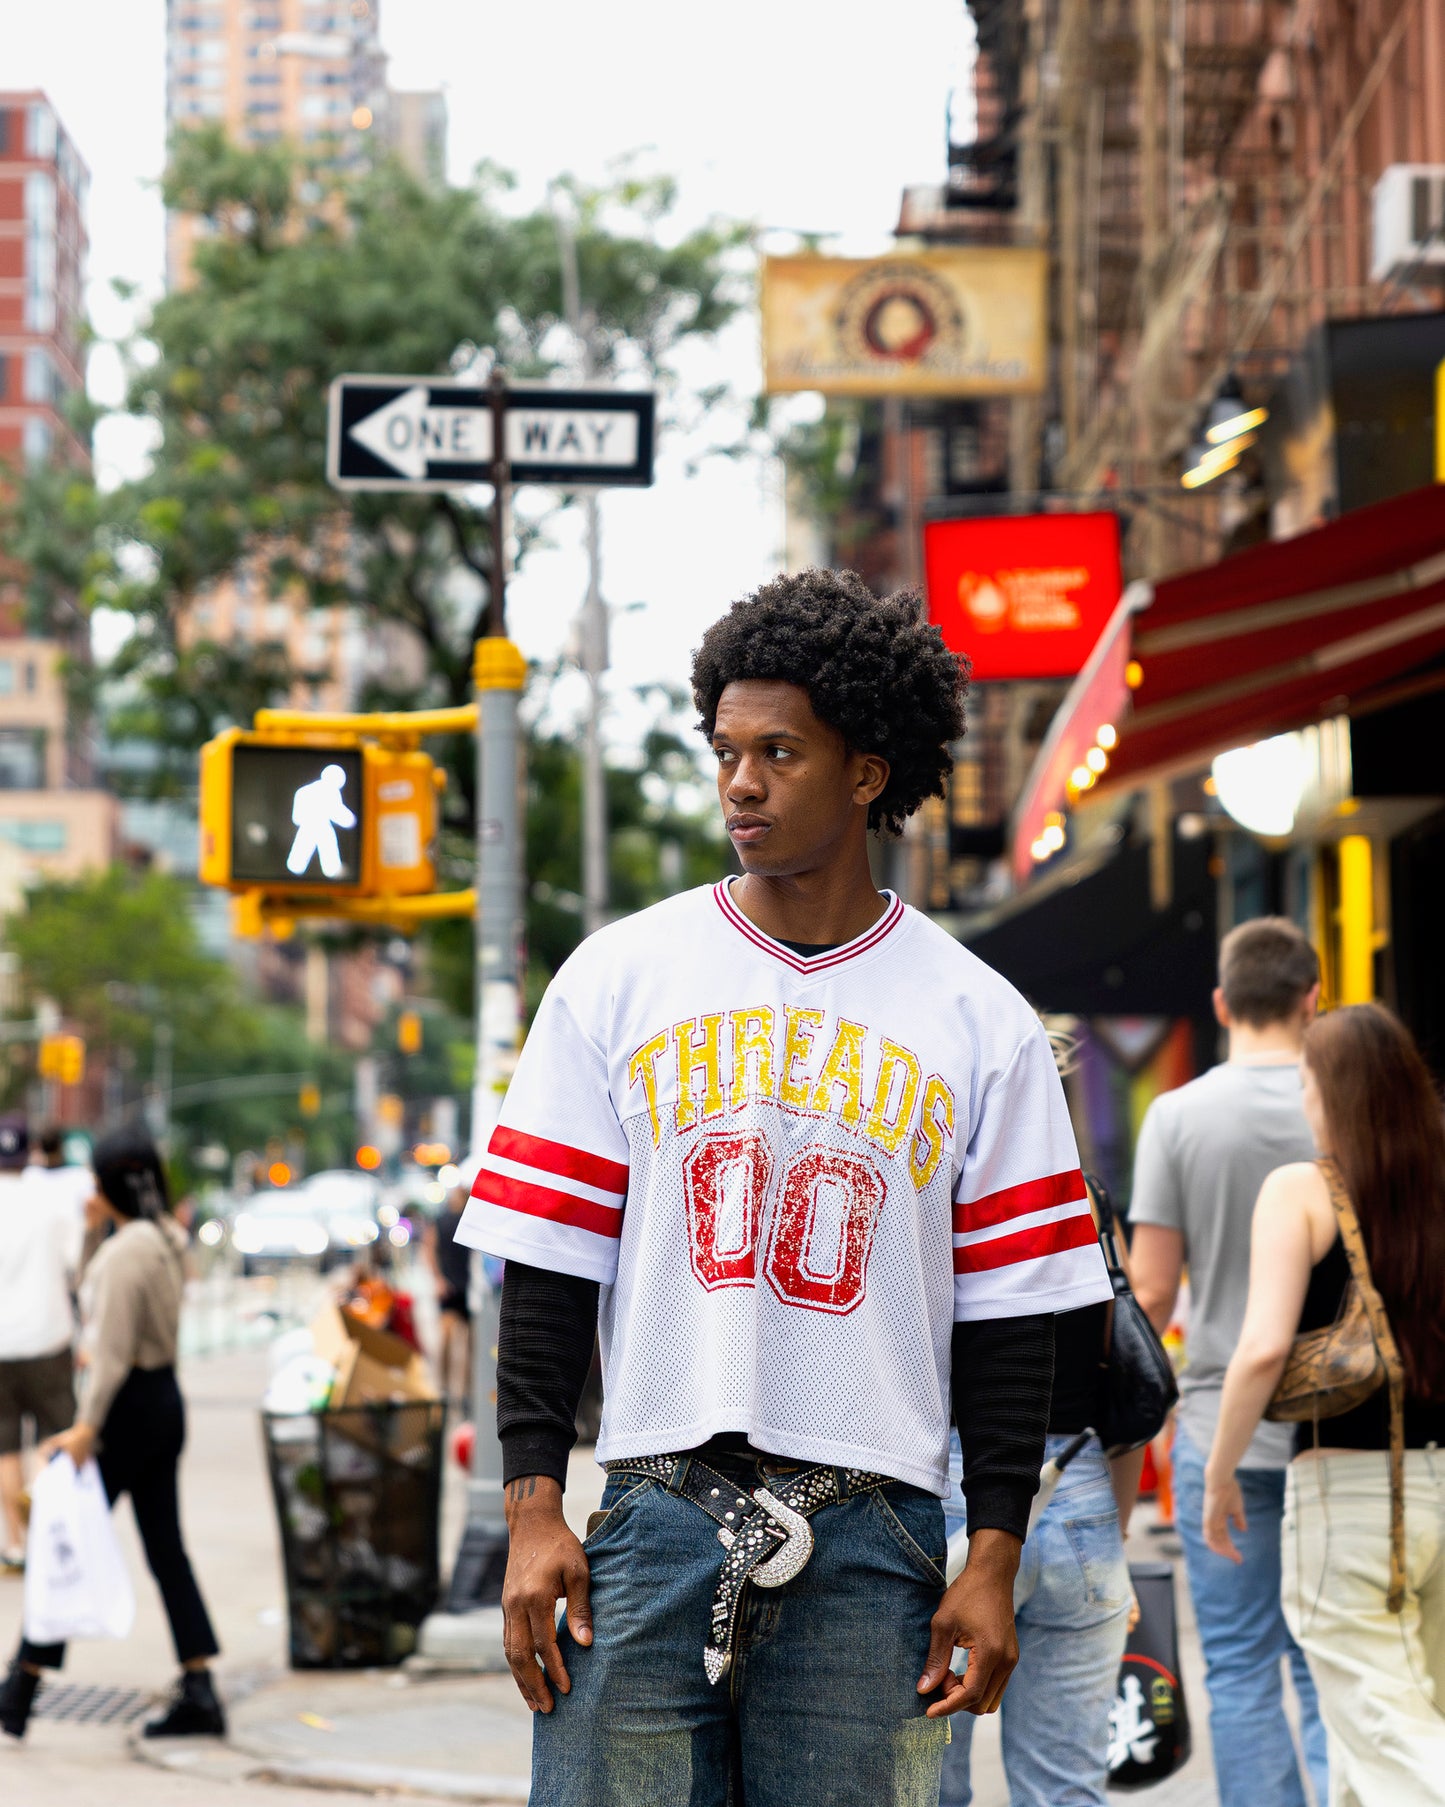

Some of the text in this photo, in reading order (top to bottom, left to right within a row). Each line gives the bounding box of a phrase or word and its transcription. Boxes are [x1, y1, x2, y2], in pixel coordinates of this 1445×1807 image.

[386, 413, 615, 454] ONE WAY
[628, 1004, 956, 1194] THREADS
[682, 1128, 888, 1317] 00
